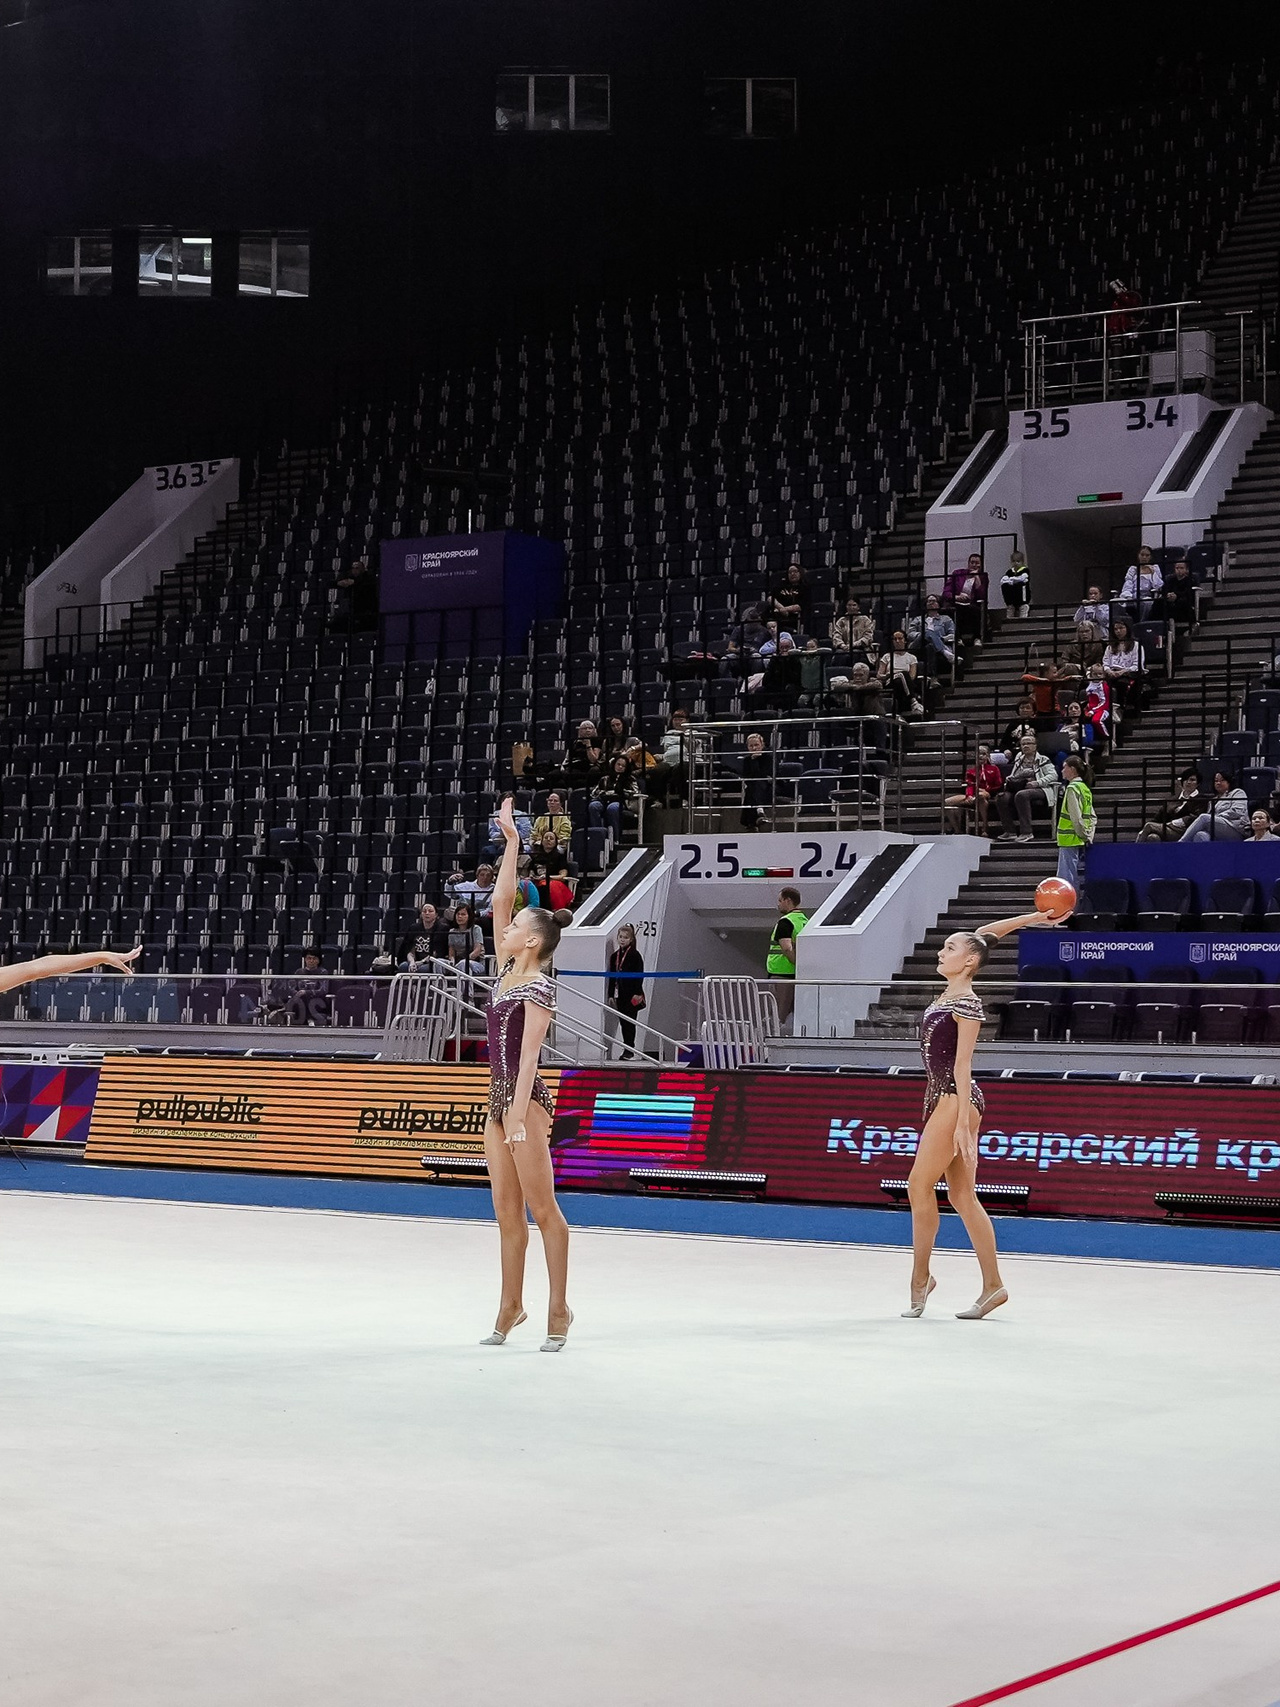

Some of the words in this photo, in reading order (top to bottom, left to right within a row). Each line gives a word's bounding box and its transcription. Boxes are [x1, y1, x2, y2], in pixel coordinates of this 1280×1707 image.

[1023, 408, 1070, 440] 3.5
[1126, 398, 1178, 431] 3.4
[156, 466, 187, 491] 3.6
[422, 548, 479, 560] КРАСНОЯРСКИЙ
[422, 559, 441, 568] КРАЙ
[679, 842, 740, 879] 2.5
[799, 842, 857, 878] 2.4
[1081, 942, 1154, 951] КРАСНОЯРСКИЙ
[1081, 951, 1105, 960] КРАЙ
[1212, 952, 1237, 961] КРАЙ
[136, 1094, 264, 1125] pullpublic
[358, 1102, 488, 1135] pullpubli
[826, 1118, 1200, 1173] Краоярский
